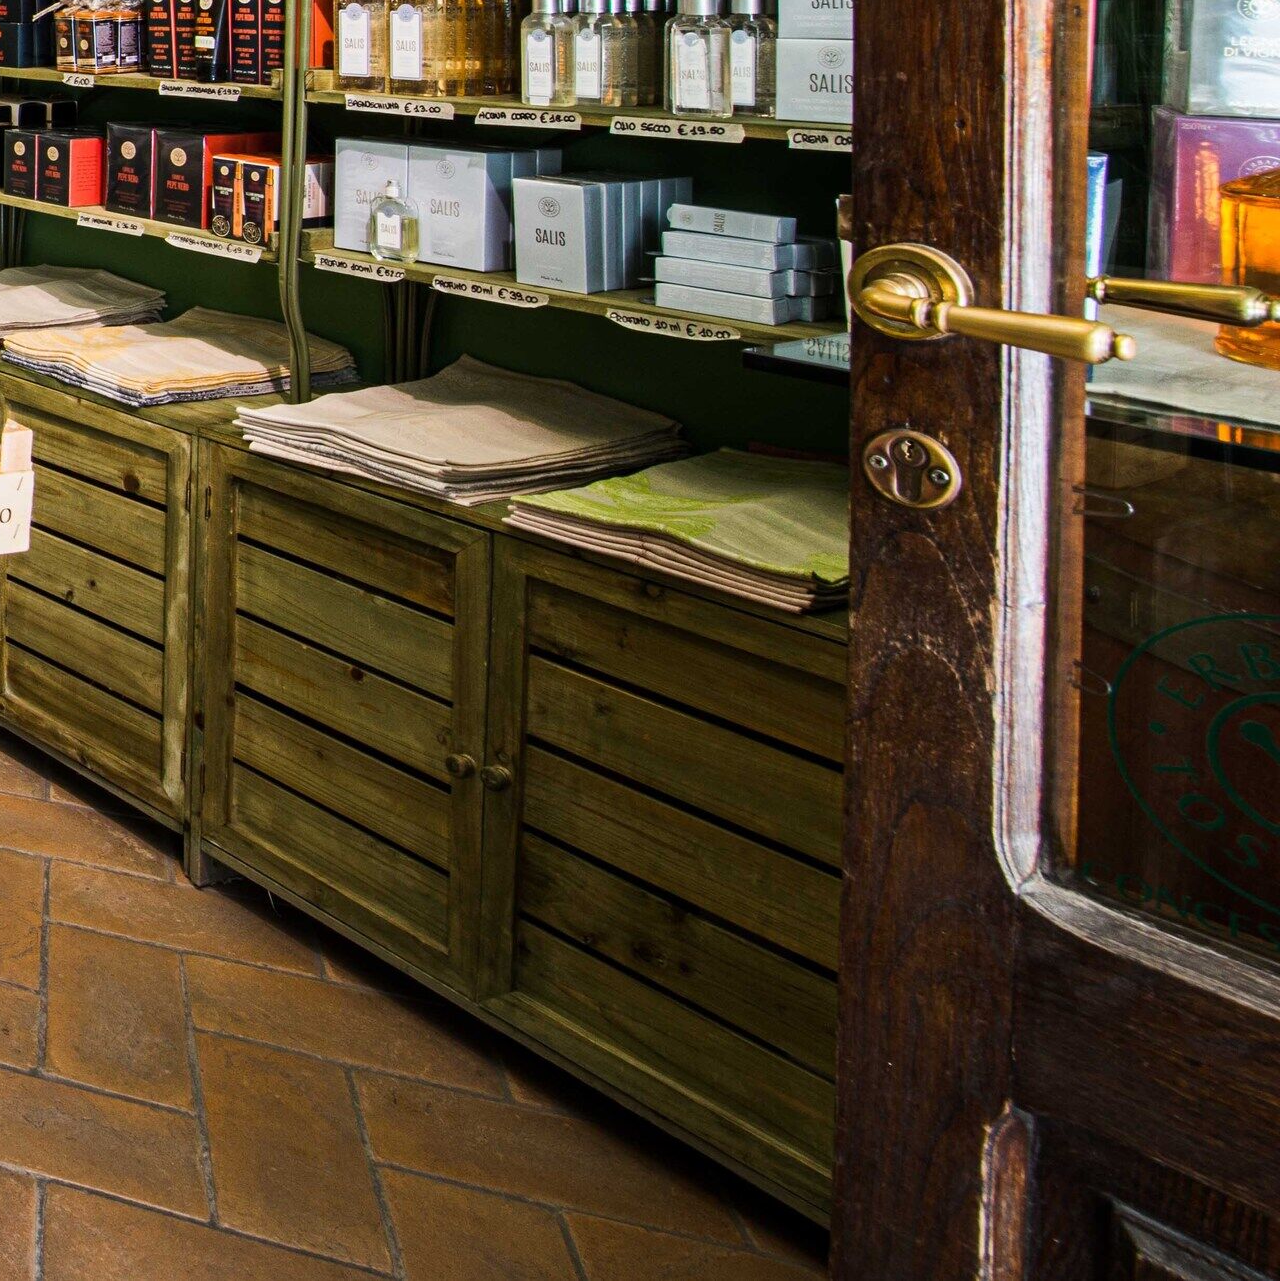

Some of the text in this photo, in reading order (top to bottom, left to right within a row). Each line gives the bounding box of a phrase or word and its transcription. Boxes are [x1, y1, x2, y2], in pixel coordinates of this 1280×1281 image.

[344, 36, 365, 50] SALIS
[395, 38, 417, 53] SALIS
[529, 60, 550, 73] SALIS
[577, 60, 598, 73] SALIS
[809, 73, 853, 94] SALIS
[614, 120, 636, 133] OLIO
[641, 124, 671, 135] SECCO
[793, 132, 827, 146] CREMA
[430, 199, 460, 218] SALIS
[380, 221, 397, 234] SALIS
[714, 211, 725, 233] SALIS
[535, 227, 566, 246] SALIS
[610, 312, 651, 328] PROFUMO
[654, 318, 681, 333] 10ml
